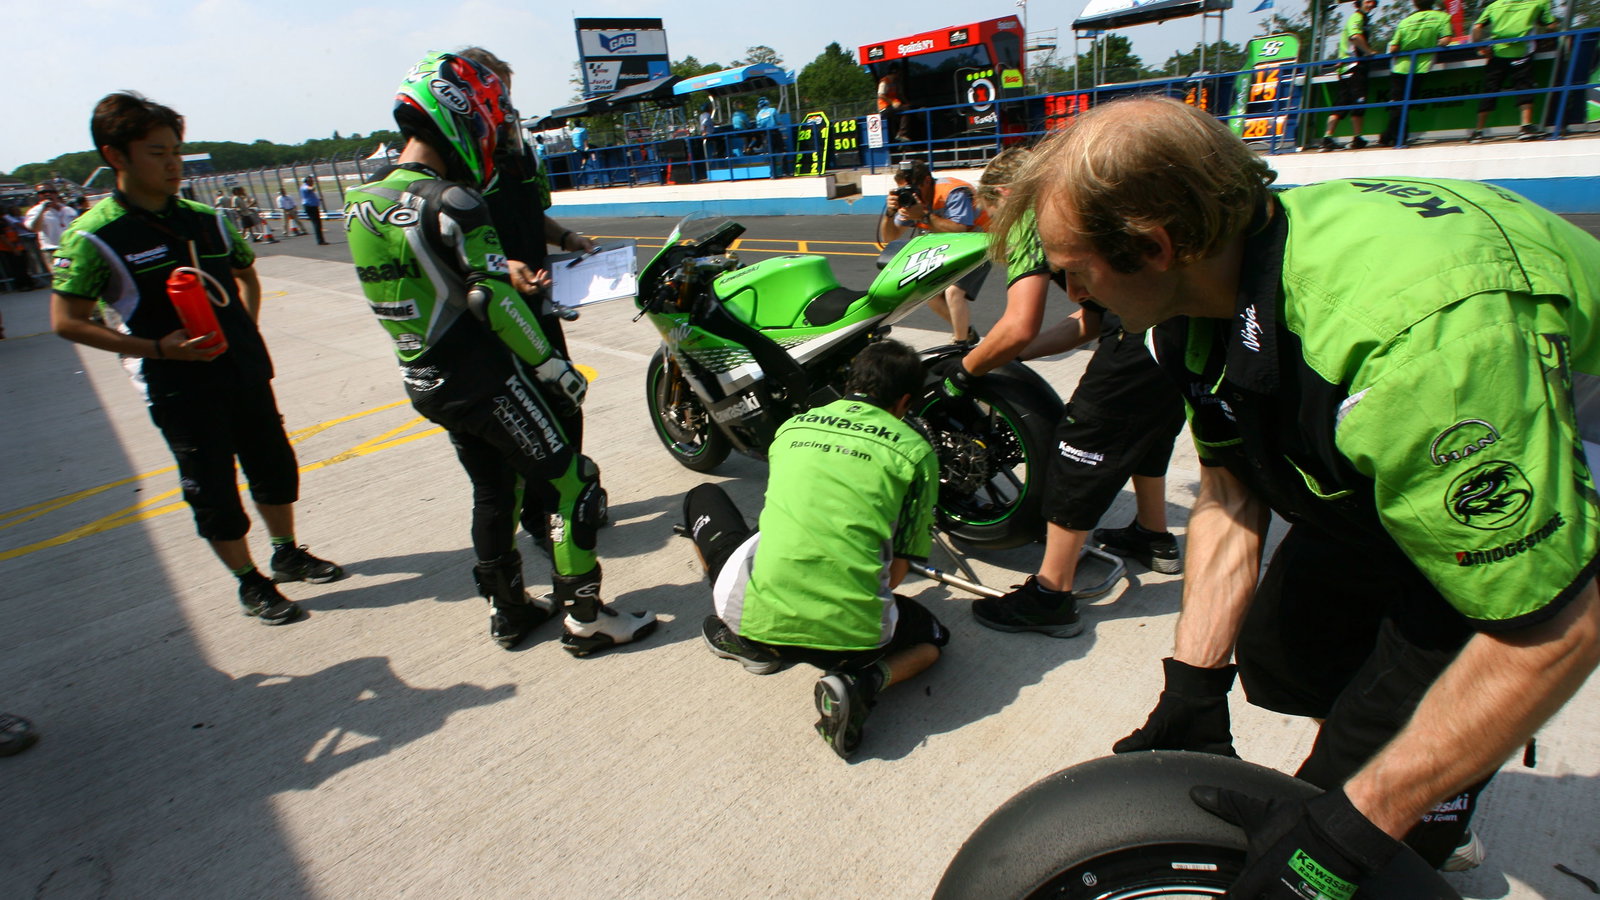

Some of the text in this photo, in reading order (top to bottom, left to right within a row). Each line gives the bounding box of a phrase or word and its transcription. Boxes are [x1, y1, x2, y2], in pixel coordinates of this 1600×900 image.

[609, 35, 635, 51] GAS
[430, 80, 469, 111] Arai
[834, 119, 857, 133] 123
[834, 138, 857, 150] 501
[500, 296, 549, 356] Kawasaki
[1239, 303, 1264, 352] Ninja
[505, 374, 564, 454] Kawasaki
[793, 414, 902, 443] Kawasaki
[789, 440, 873, 462] Racing Team
[1058, 440, 1105, 462] Kawasaki
[1438, 432, 1496, 464] MAN
[1296, 851, 1356, 895] Kawasaki
